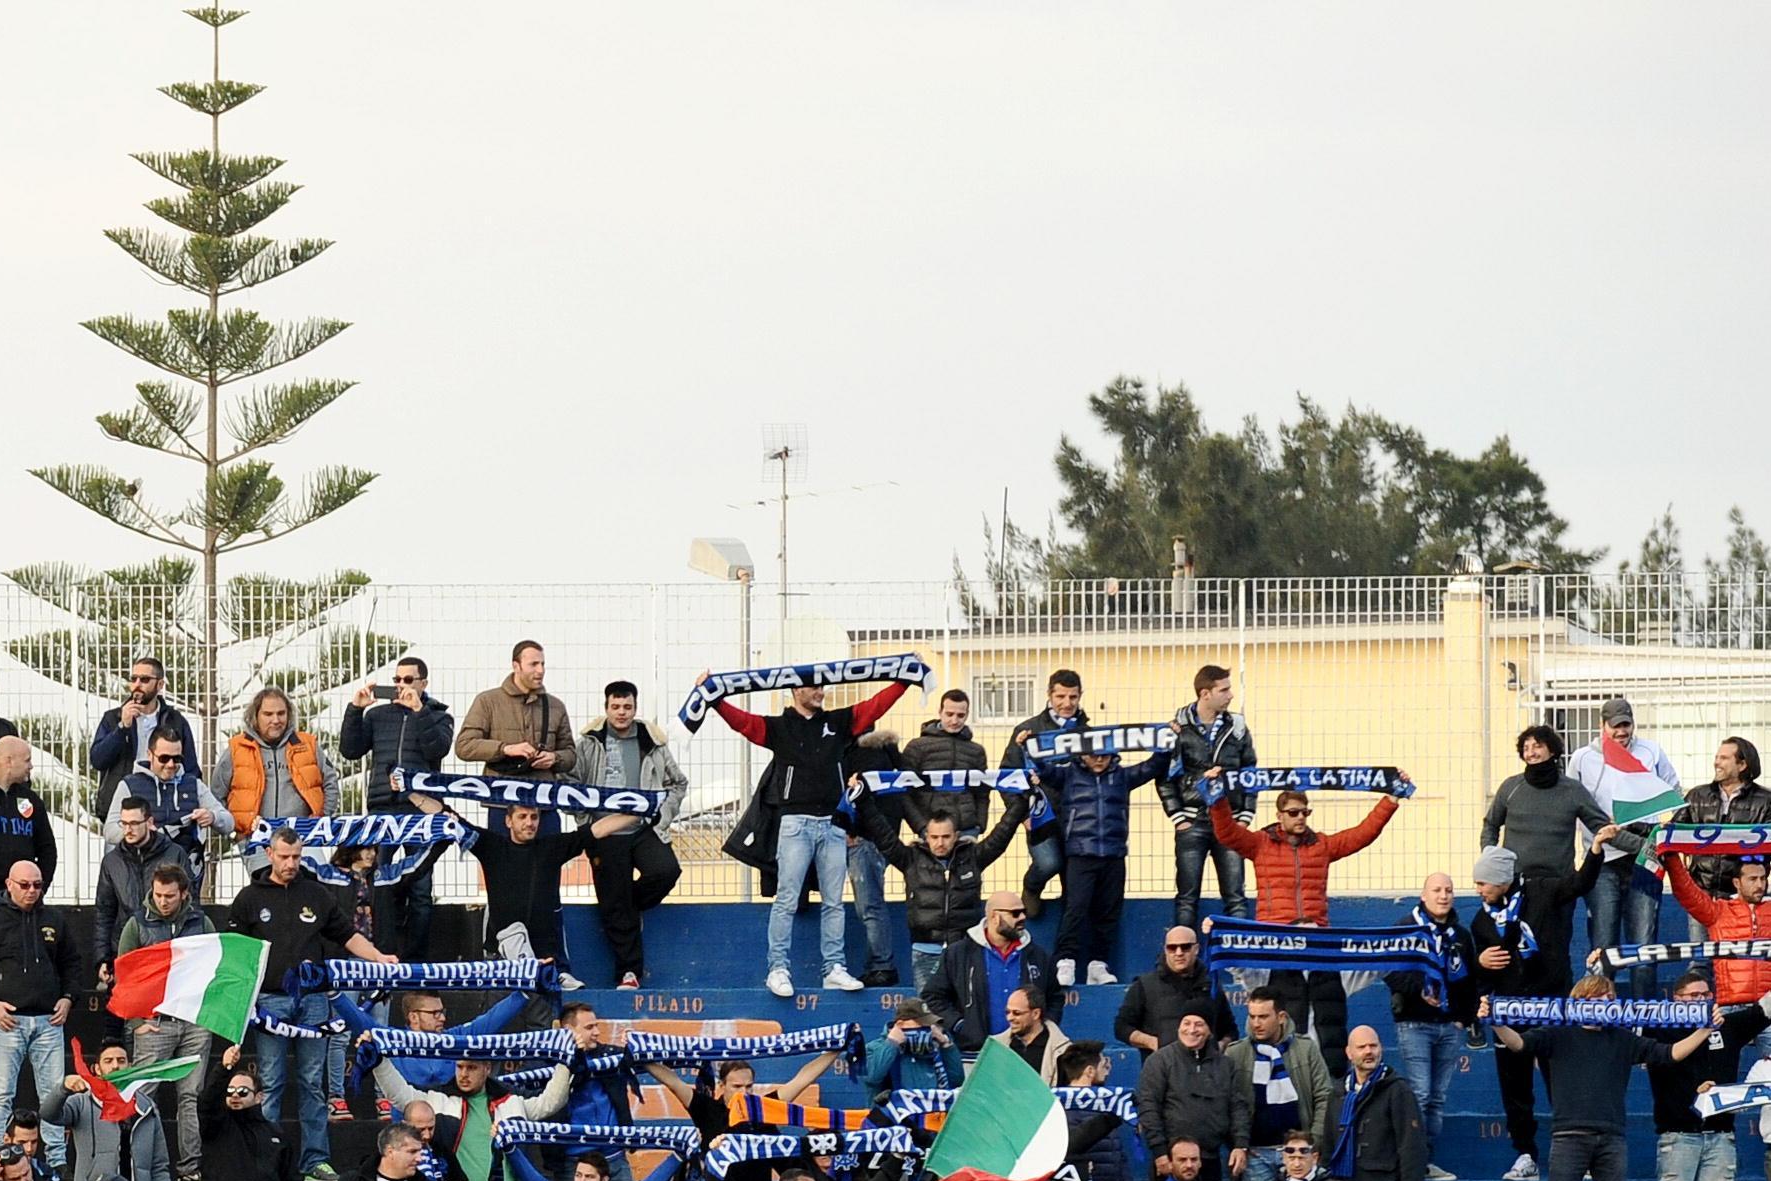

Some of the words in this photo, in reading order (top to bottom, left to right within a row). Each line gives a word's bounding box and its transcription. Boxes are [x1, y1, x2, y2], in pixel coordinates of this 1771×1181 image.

[685, 667, 803, 722] CURVA
[813, 656, 924, 684] NORD
[1030, 727, 1177, 758] LATINA
[863, 769, 1030, 792] LATINA
[1227, 766, 1300, 790] FORZA
[1308, 766, 1388, 788] LATINA
[286, 814, 432, 845] LATINA
[1221, 933, 1307, 951] ULTRAS
[1341, 936, 1430, 954] LATINA
[1605, 939, 1771, 968] LATINA
[796, 995, 819, 1010] 97
[1493, 1001, 1563, 1022] FORZA
[1565, 1000, 1708, 1025] NEROAZZURRI
